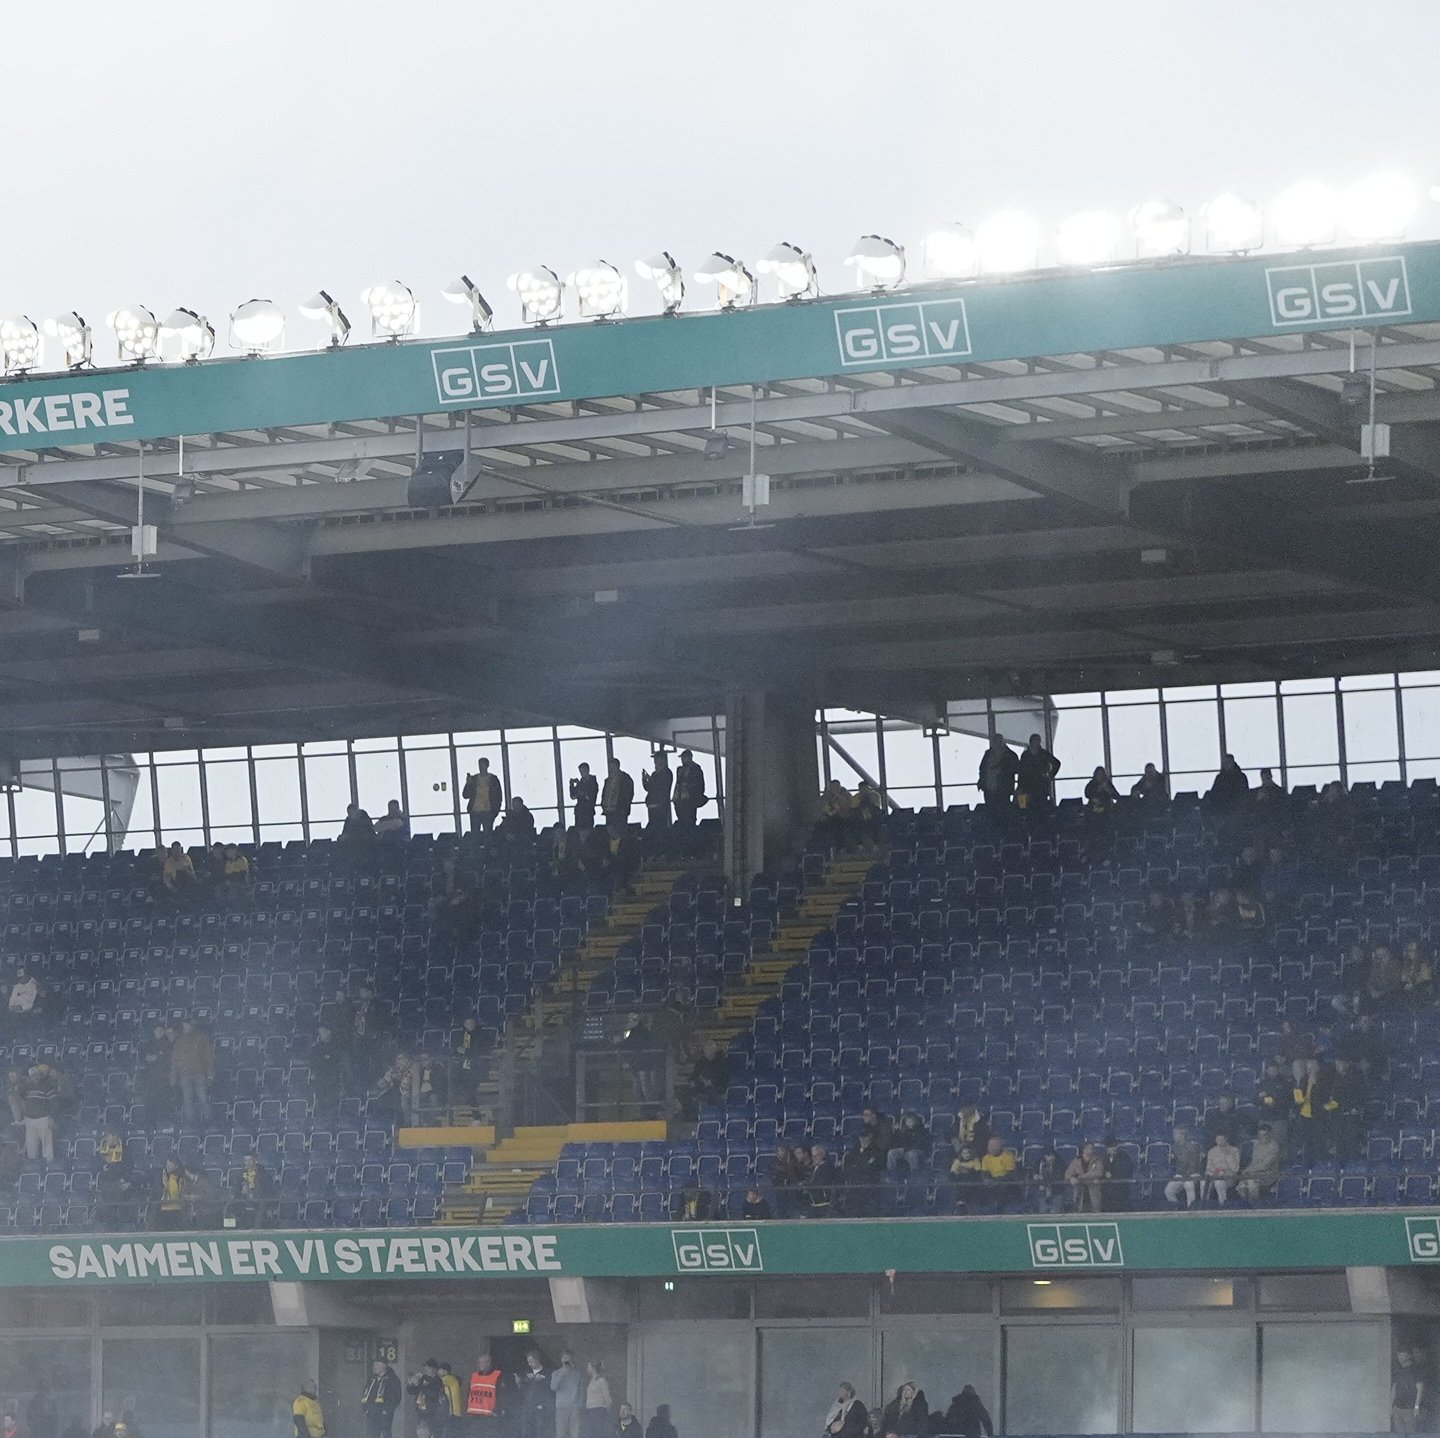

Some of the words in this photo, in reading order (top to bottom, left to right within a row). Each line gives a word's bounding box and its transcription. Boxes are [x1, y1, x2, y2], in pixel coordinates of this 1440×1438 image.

[1269, 281, 1402, 323] GSV
[843, 319, 960, 360] GSV
[442, 361, 552, 399] GSV
[50, 1242, 222, 1279] SAMMEN
[231, 1240, 280, 1275] ER
[284, 1240, 330, 1273] VI
[336, 1235, 561, 1273] STÆRKERE
[679, 1243, 756, 1267] GSV
[1034, 1238, 1117, 1262] GSV
[380, 1346, 396, 1361] 18
